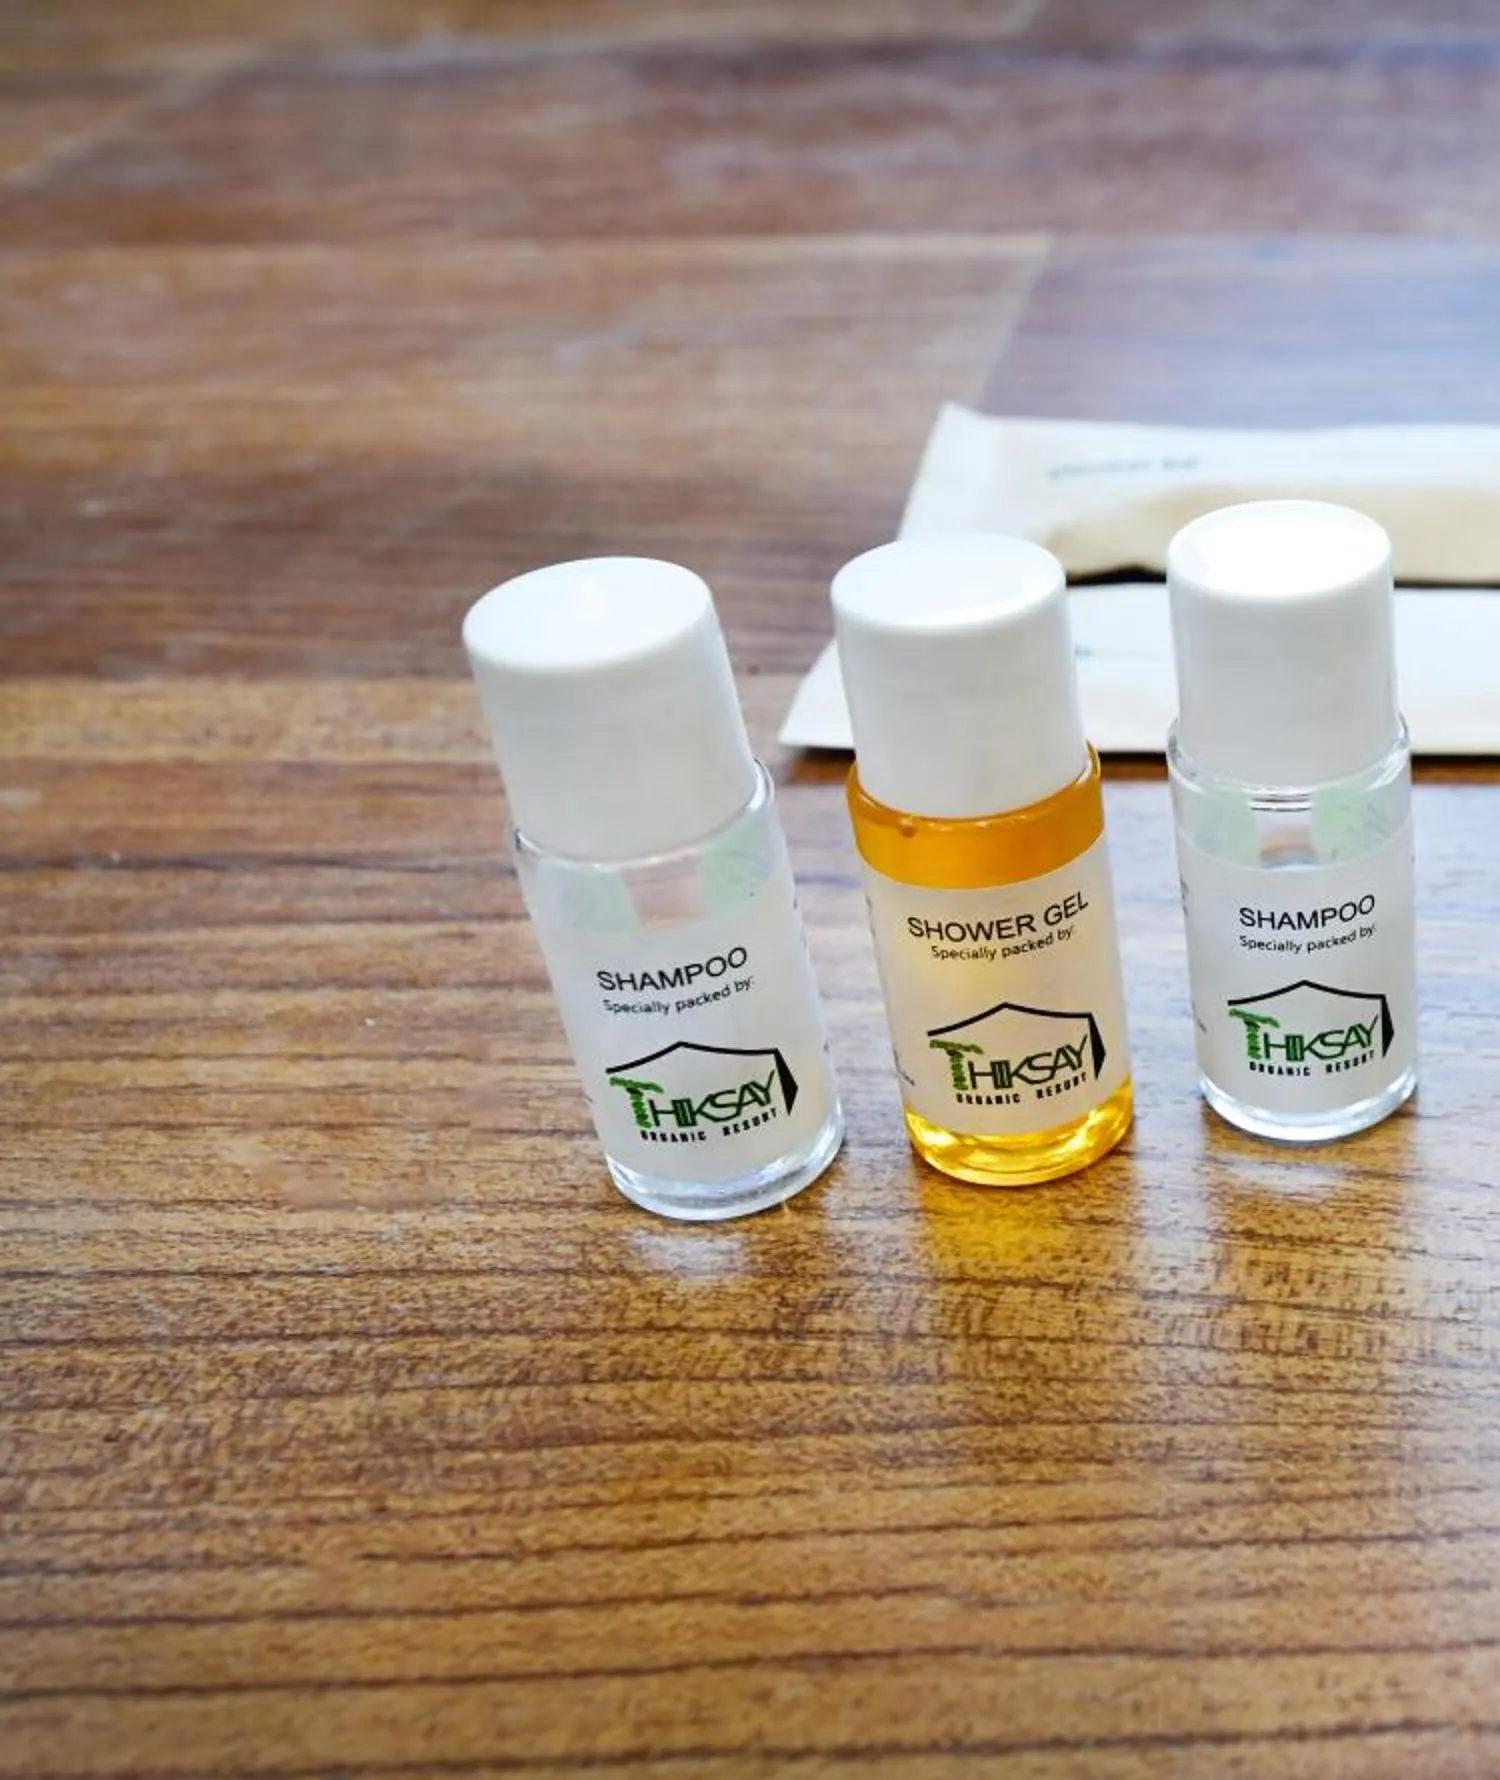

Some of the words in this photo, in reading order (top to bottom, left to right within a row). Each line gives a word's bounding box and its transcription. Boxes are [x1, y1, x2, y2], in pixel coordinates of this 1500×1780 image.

[906, 914, 1037, 943] SHOWER
[1043, 891, 1089, 926] GEL
[1239, 894, 1375, 930] SHAMPOO
[931, 945, 997, 962] Specially
[1001, 931, 1053, 959] packed
[1239, 936, 1302, 954] Specially
[1307, 930, 1356, 953] packed
[596, 946, 748, 992] SHAMPOO
[603, 999, 671, 1015] Specially
[676, 984, 731, 1014] packed
[1228, 1007, 1379, 1062] THIKSAY
[929, 1033, 1088, 1091] THIKSAY
[1249, 1061, 1310, 1077] ORGANIC
[1325, 1049, 1375, 1073] RESORT
[609, 1069, 775, 1129] THIKSAY
[956, 1092, 1021, 1105] ORGANIC
[1036, 1071, 1087, 1100] RESORT
[640, 1130, 707, 1143] ORGANIC
[721, 1108, 778, 1137] RESORT
